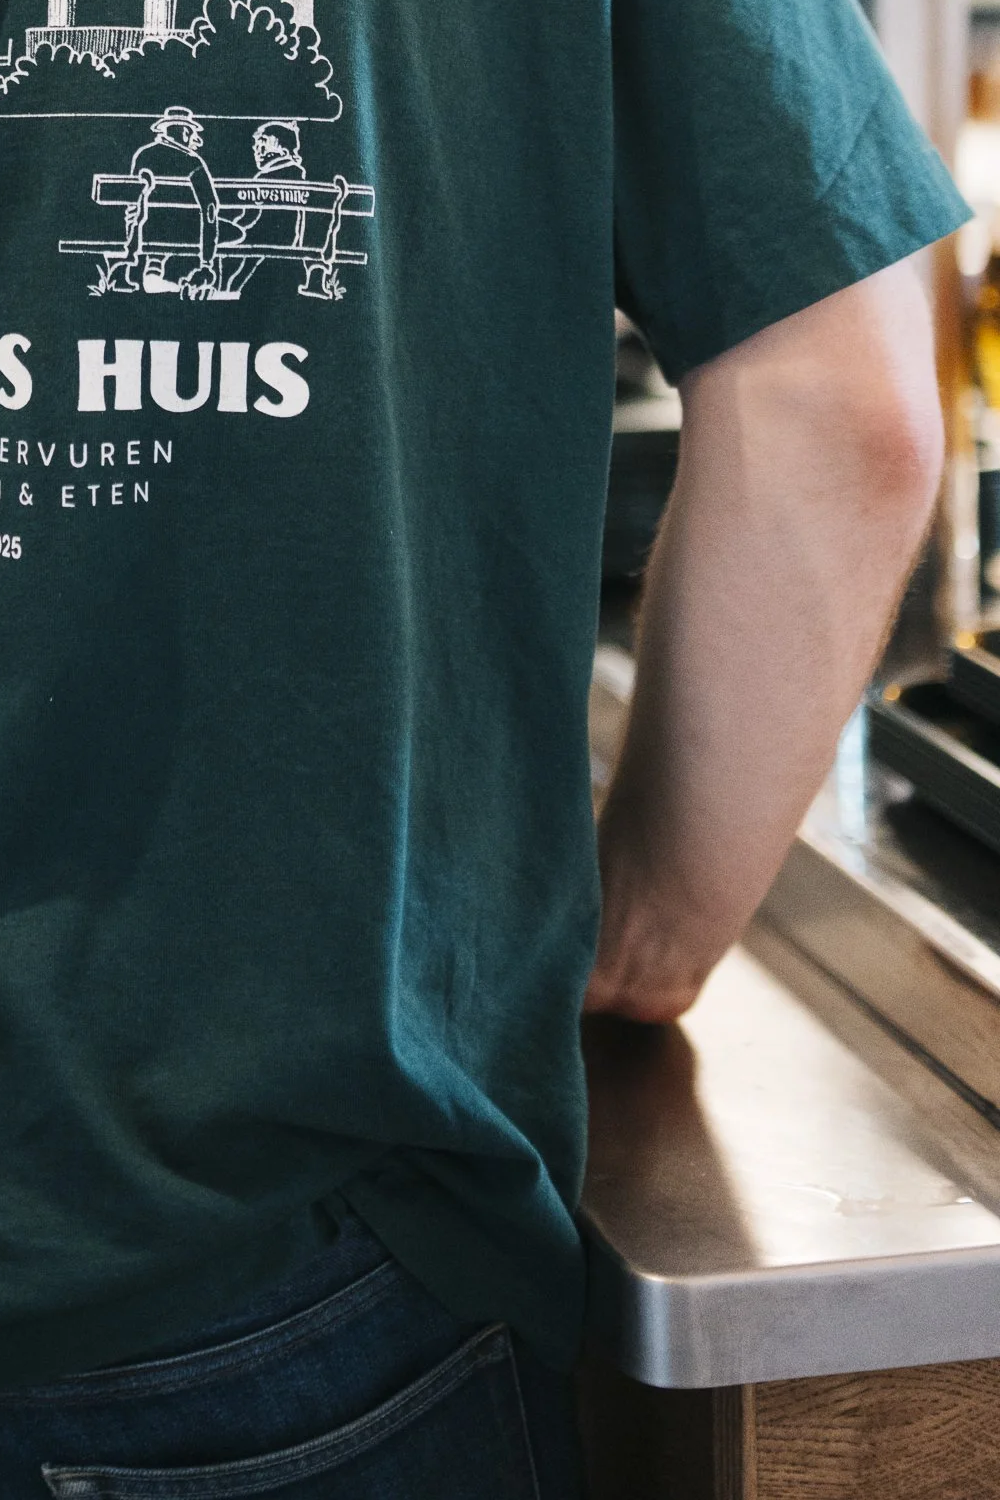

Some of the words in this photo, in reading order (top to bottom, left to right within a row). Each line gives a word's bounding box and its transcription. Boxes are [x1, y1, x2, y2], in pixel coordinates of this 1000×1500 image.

[76, 338, 310, 418] HUIS
[18, 482, 34, 506] &
[61, 481, 149, 508] ETEN
